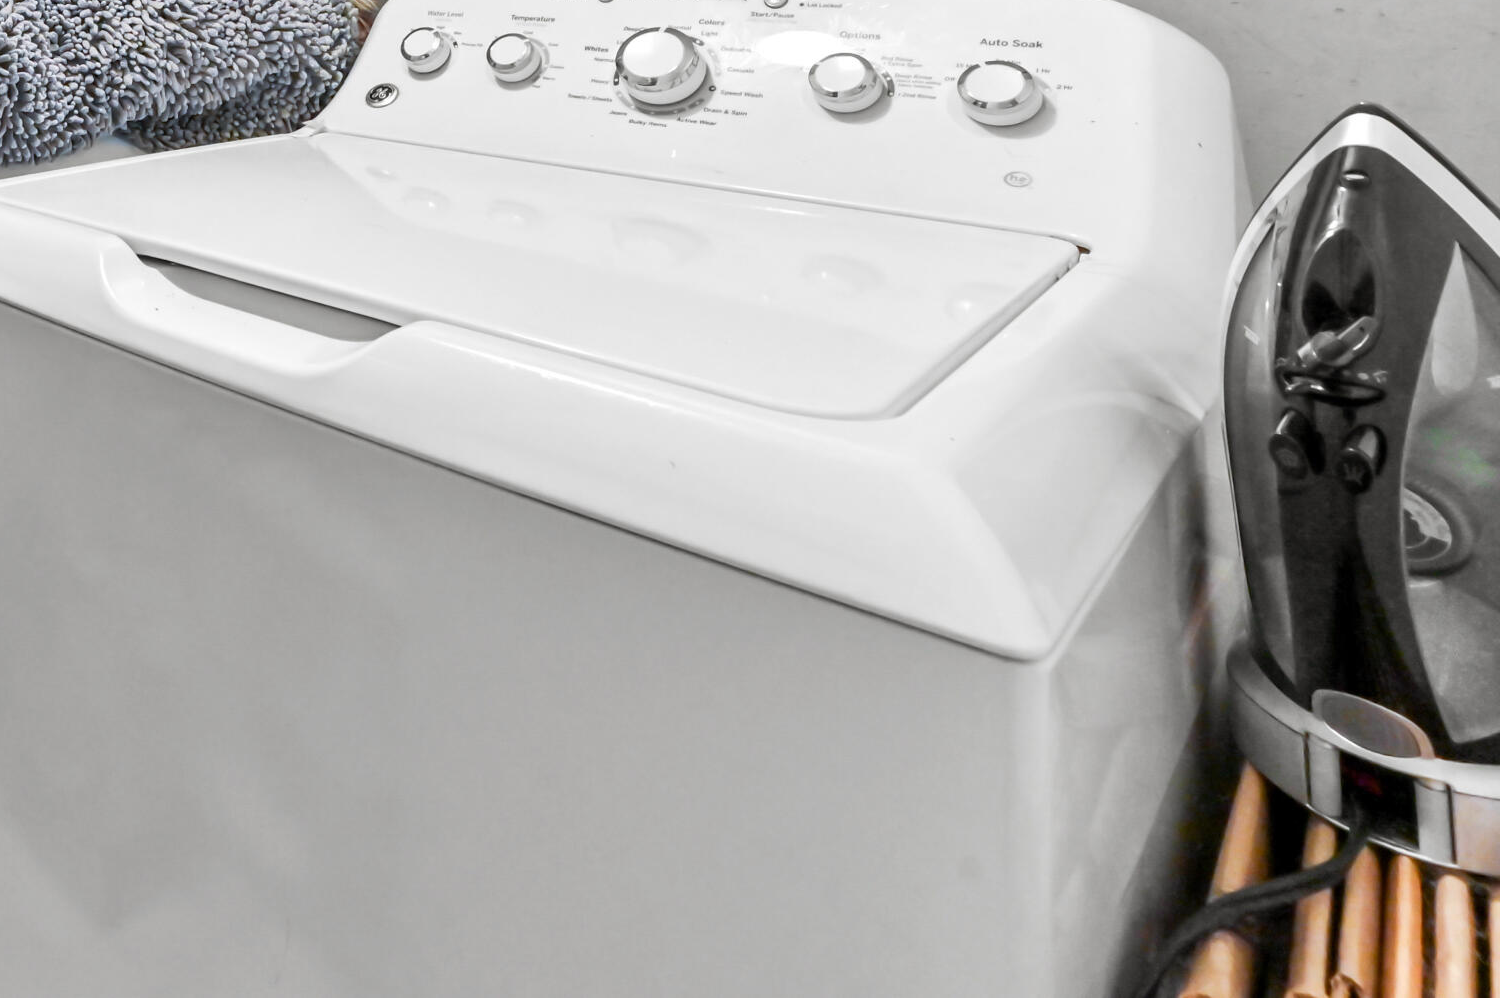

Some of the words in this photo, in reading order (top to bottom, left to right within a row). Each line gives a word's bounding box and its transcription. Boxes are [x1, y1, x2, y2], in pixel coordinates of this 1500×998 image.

[511, 15, 556, 24] Temperature
[839, 30, 881, 41] Options
[980, 38, 1008, 47] Auto
[1012, 39, 1044, 49] Soak
